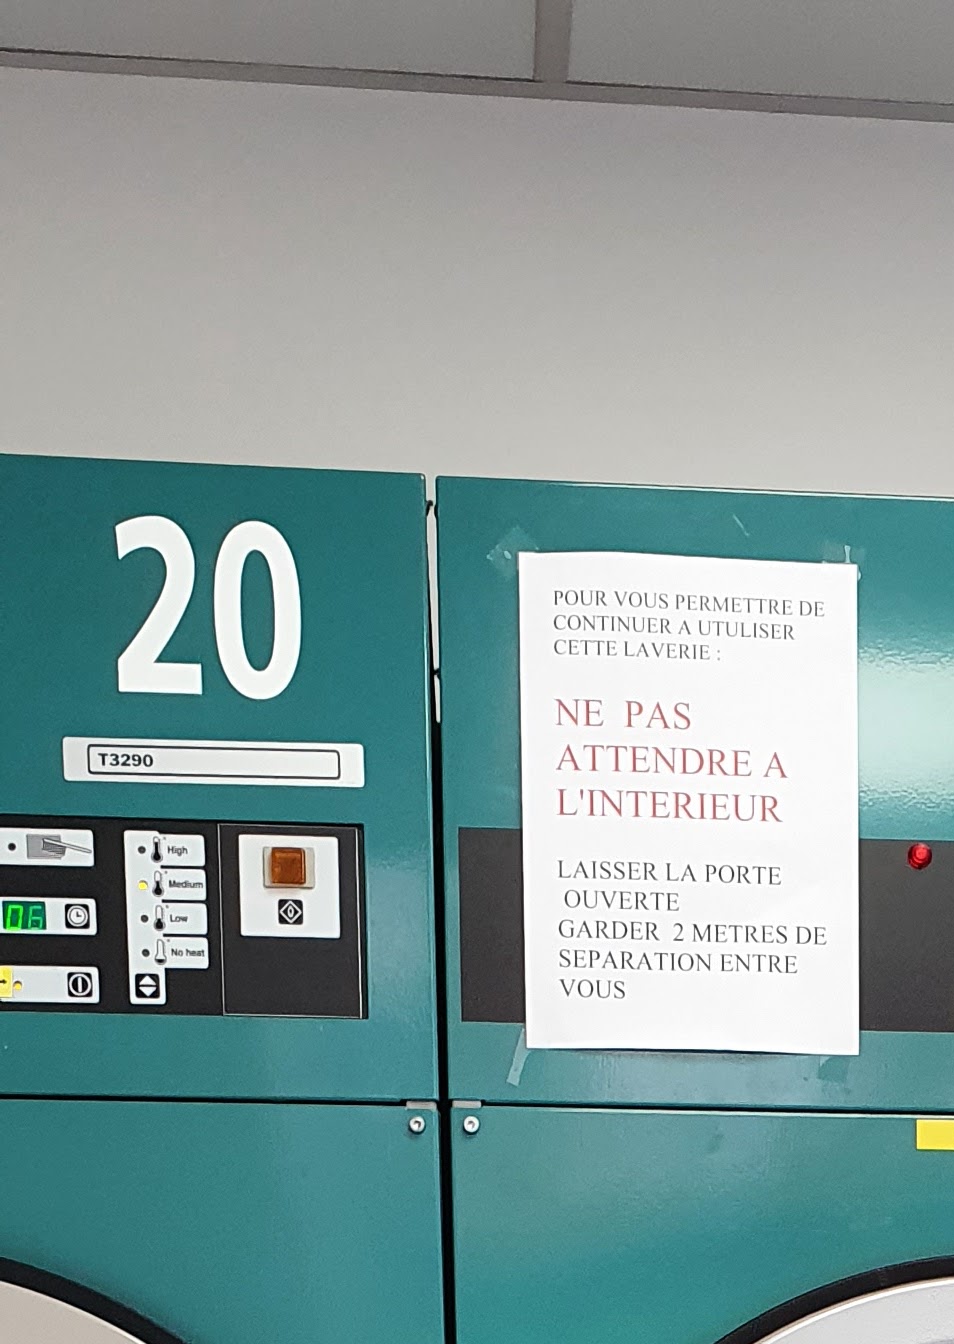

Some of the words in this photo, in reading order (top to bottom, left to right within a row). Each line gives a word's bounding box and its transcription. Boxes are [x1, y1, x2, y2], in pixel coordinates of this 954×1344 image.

[114, 515, 302, 700] 20
[553, 589, 608, 607] POUR
[613, 590, 669, 610] VOUS
[675, 594, 793, 616] PERMETTRE
[799, 600, 825, 617] DE
[553, 614, 672, 635] CONTINUER
[677, 619, 692, 636] A
[698, 619, 795, 641] UTULISER
[553, 639, 618, 657] CETTE
[624, 640, 710, 660] LAVERIE
[554, 698, 604, 727] NE
[625, 700, 691, 731] PAS
[97, 752, 154, 768] T3290
[555, 743, 752, 777] ATTENDRE
[763, 751, 788, 779] A
[557, 788, 783, 823] L'INTERIEUR
[167, 845, 189, 857] High
[168, 879, 204, 889] Medium
[558, 859, 658, 881] LAISSER
[665, 862, 697, 883] LA
[705, 864, 782, 886] PORTE
[564, 889, 680, 912] OUVERTE
[169, 913, 189, 923] Low
[558, 919, 660, 941] GARDER
[672, 922, 684, 942] 2
[692, 923, 788, 945] METRES
[796, 926, 827, 946] DE
[170, 947, 183, 957] No
[185, 948, 205, 958] heat
[559, 948, 711, 972] SEPARATION
[720, 953, 798, 974] ENTRE
[559, 978, 626, 999] VOUS
